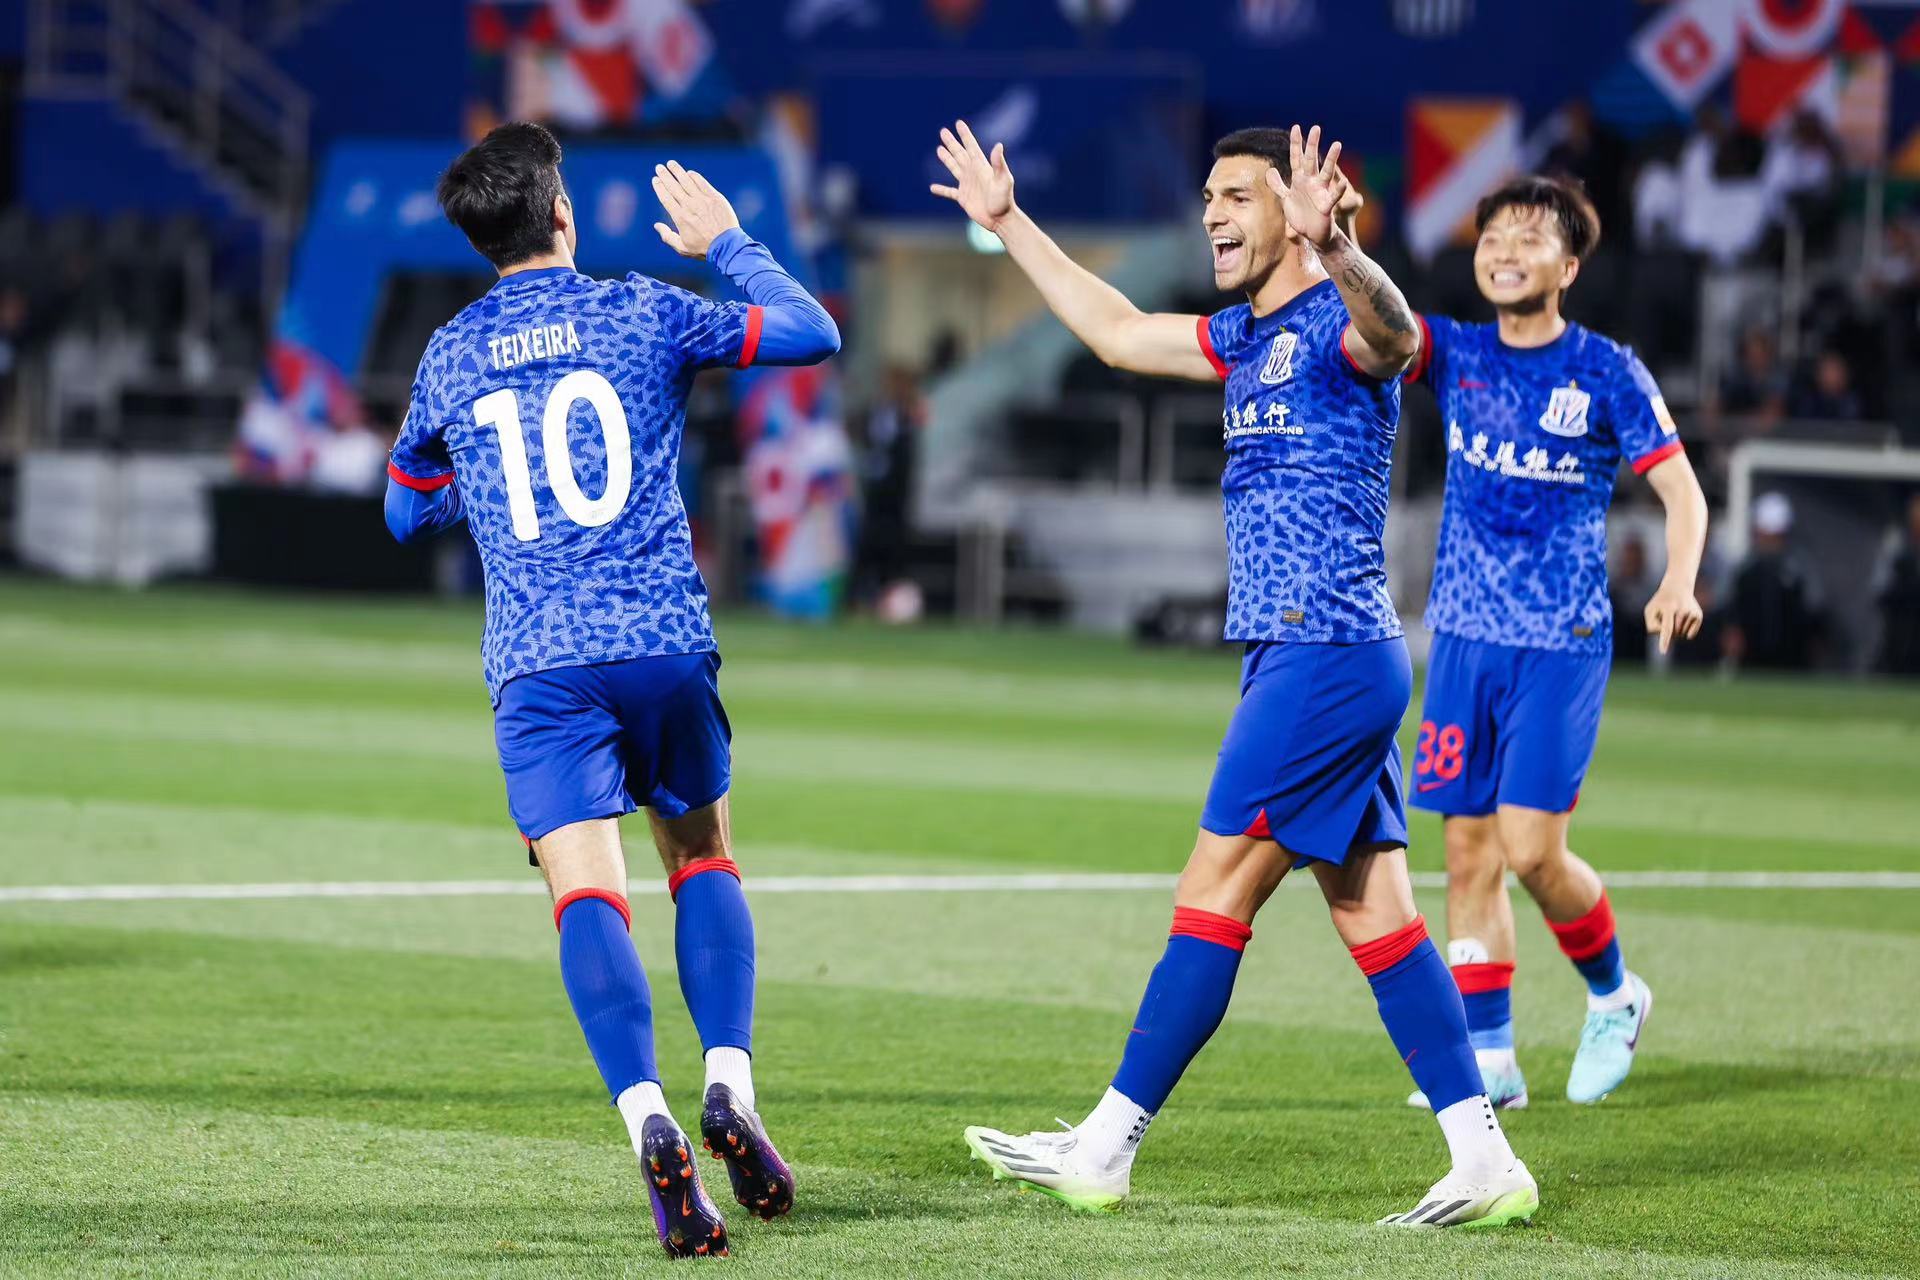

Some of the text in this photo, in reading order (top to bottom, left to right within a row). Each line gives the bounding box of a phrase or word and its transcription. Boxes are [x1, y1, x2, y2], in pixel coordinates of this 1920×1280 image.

[488, 321, 582, 370] TEIXEIRA
[473, 370, 633, 541] 10
[1416, 720, 1465, 781] 38
